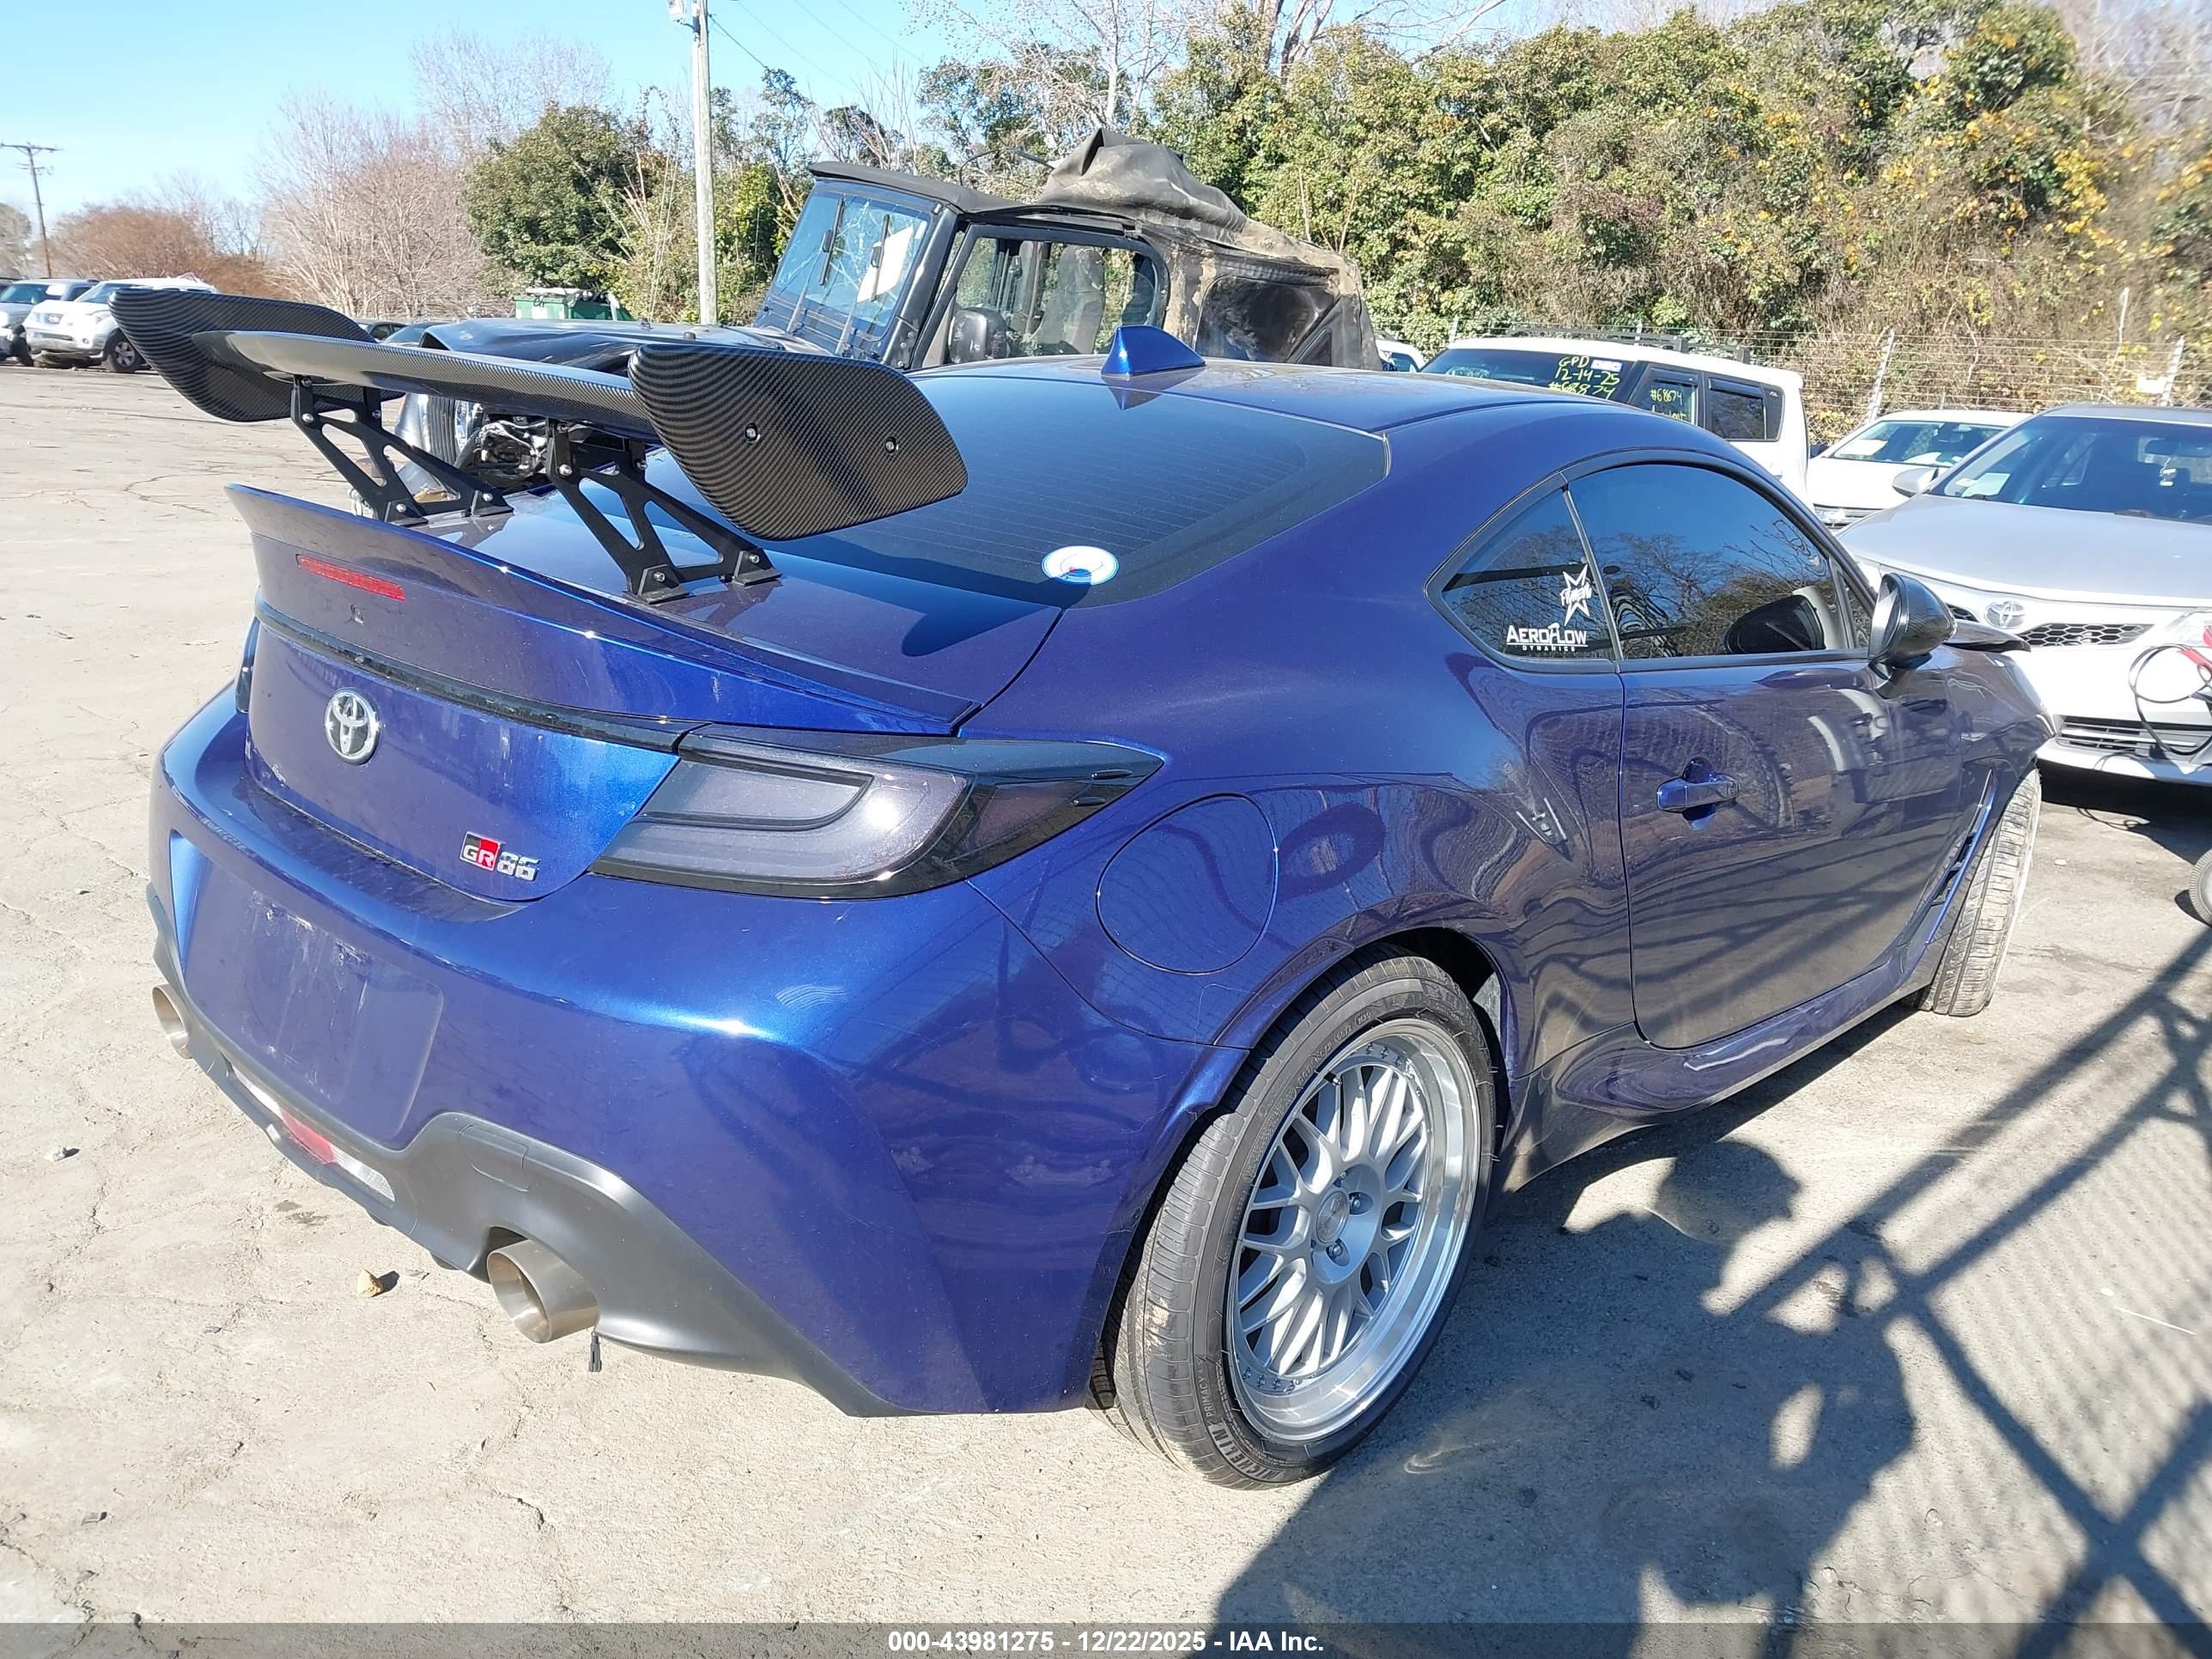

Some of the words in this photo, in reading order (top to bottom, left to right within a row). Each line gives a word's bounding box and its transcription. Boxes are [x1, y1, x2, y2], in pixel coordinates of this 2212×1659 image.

[1554, 367, 1620, 386] 12-14-25
[1559, 356, 1589, 368] GPD
[1199, 1376, 1215, 1418] PRIMACY
[1212, 1427, 1283, 1481] MICHELIN
